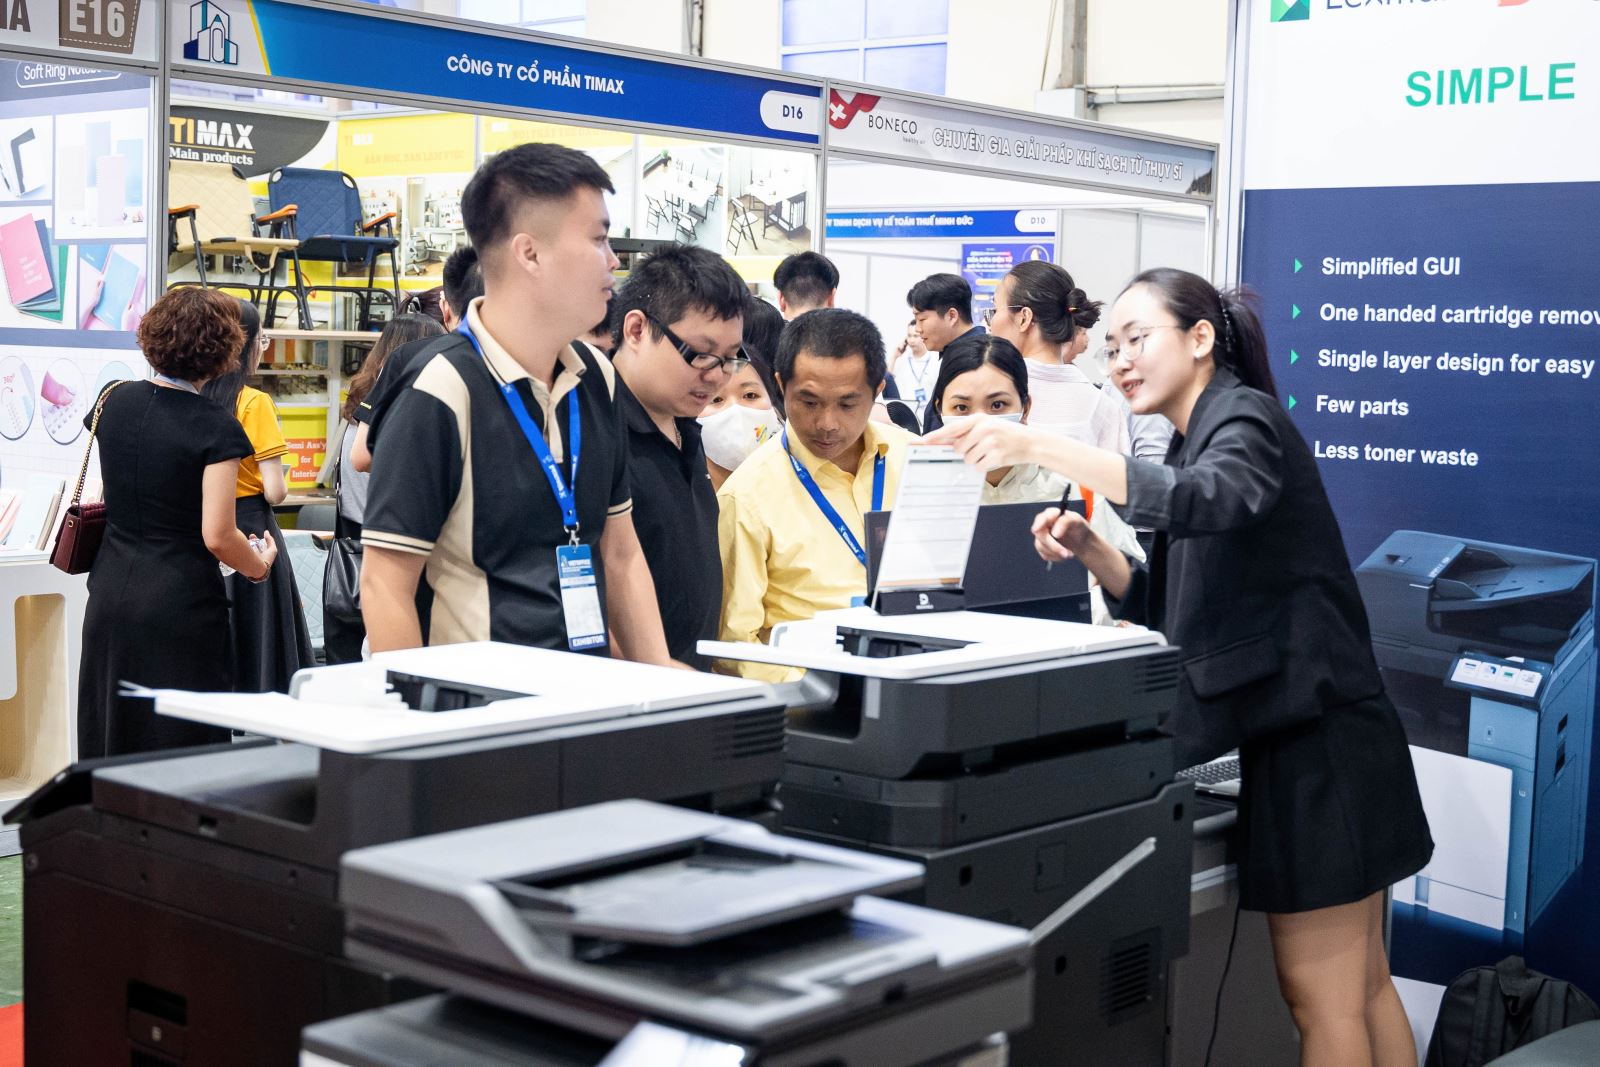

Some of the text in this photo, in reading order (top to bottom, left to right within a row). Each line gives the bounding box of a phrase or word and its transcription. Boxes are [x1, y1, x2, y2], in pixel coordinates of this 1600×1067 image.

[69, 0, 125, 38] E16
[23, 64, 44, 80] Soft
[45, 64, 66, 80] Ring
[447, 54, 625, 94] CÔNG TY CỔ PHẦN TIMAX
[1404, 62, 1576, 107] SIMPLE
[782, 104, 803, 120] D16
[868, 114, 918, 134] BONECO
[170, 116, 254, 150] TIMAX
[170, 148, 254, 166] Main products
[932, 128, 1183, 182] CHUYÊN GIA GIẢI PHÁP KHÍ SẠCH TỪ THỤY SĨ
[1030, 216, 1046, 225] D10
[1321, 256, 1461, 279] Simplified GUI
[1319, 303, 1358, 322] One
[1364, 303, 1437, 323] handed
[1441, 305, 1533, 328] cartridge
[1317, 349, 1595, 379] Single layer design for easy
[1316, 394, 1409, 418] Few parts
[1314, 441, 1479, 467] Less toner waste
